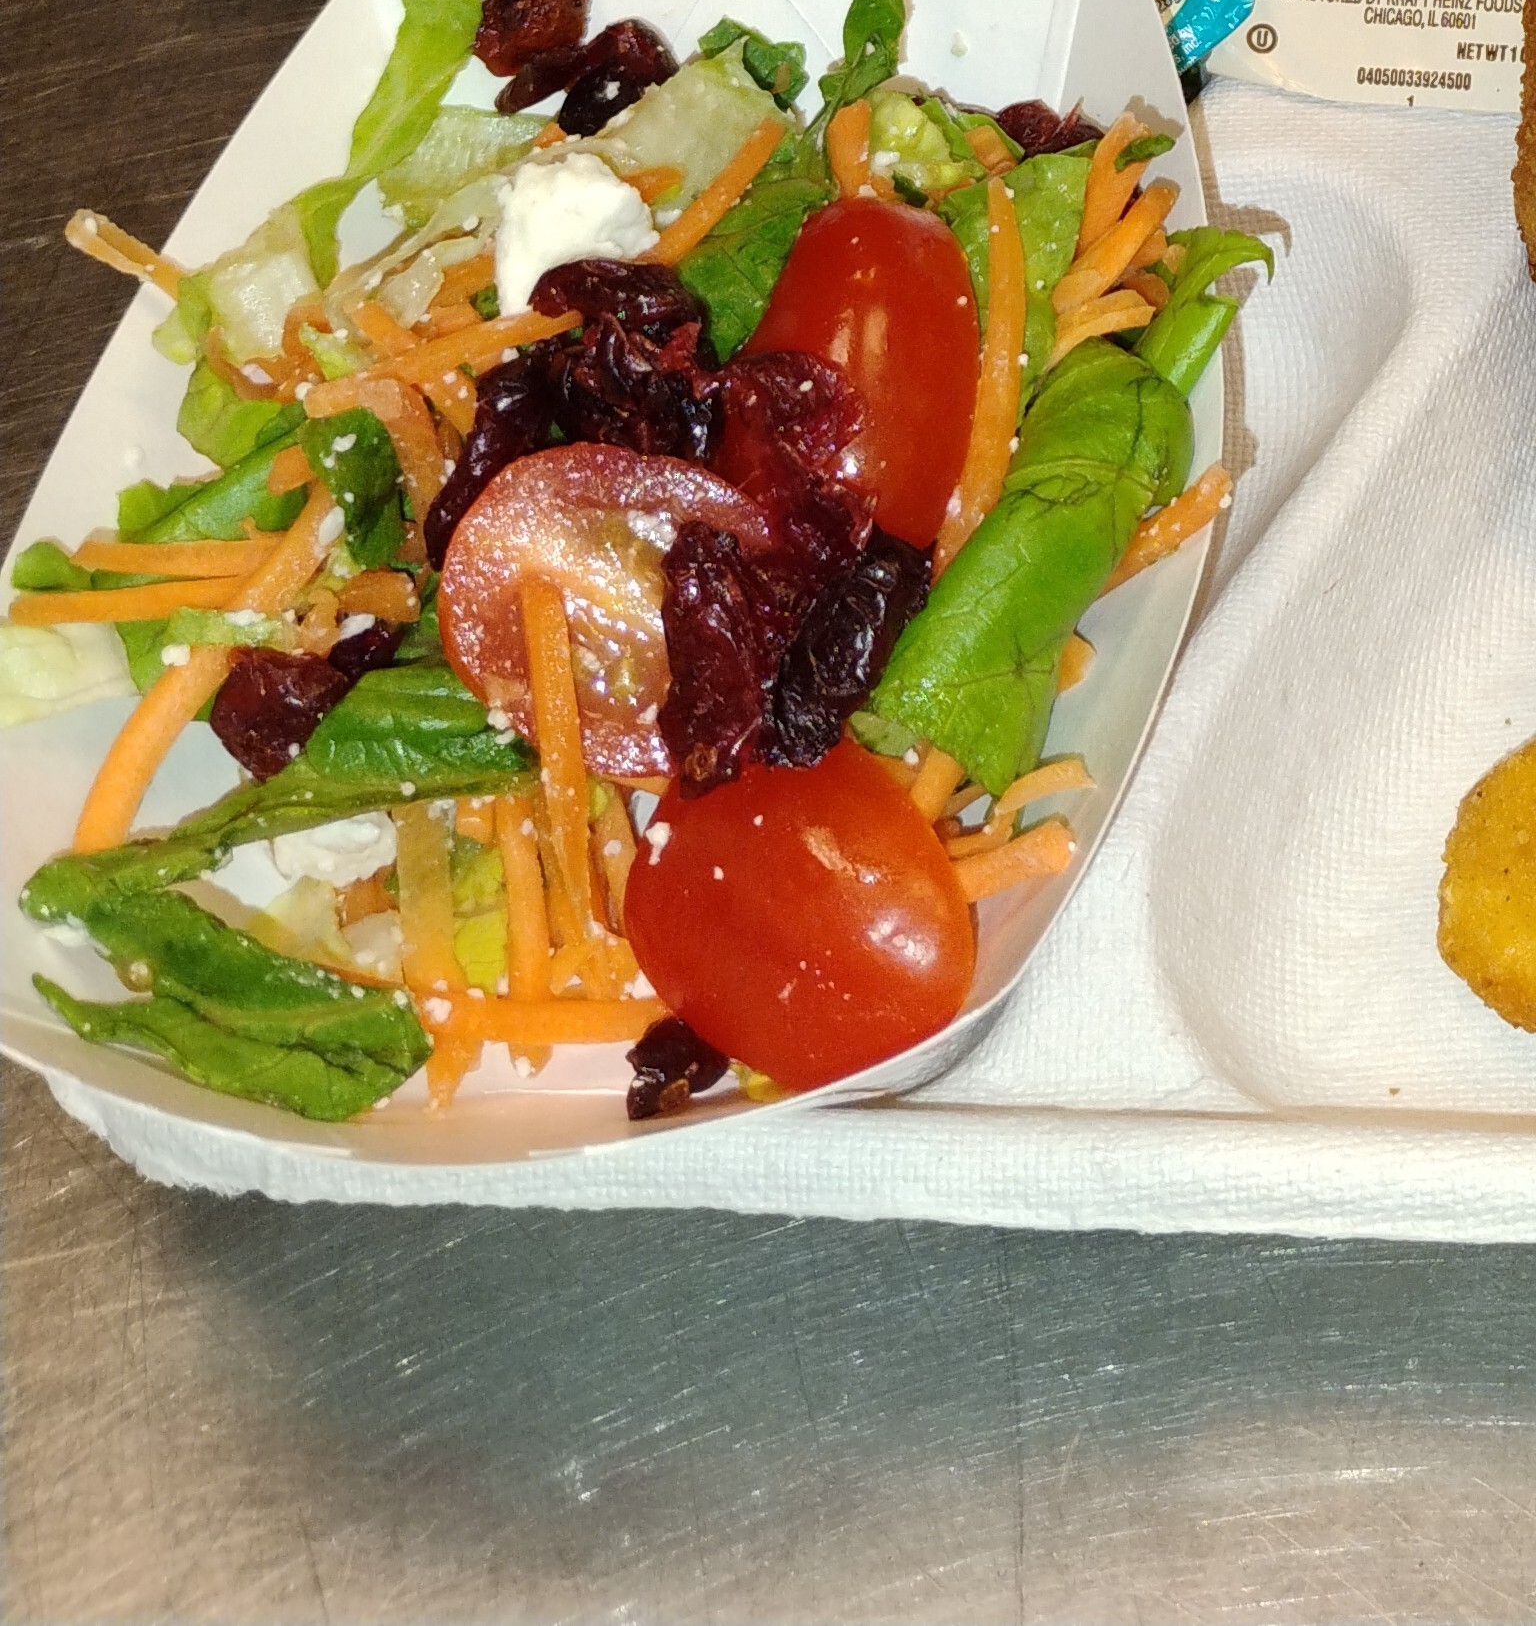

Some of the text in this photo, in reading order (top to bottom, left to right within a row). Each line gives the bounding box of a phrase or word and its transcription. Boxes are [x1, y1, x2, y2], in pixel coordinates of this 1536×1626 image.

[1363, 6, 1477, 30] CHICAGO, IL 60601
[1456, 42, 1511, 62] NET WT
[1356, 66, 1473, 91] 04050033924500
